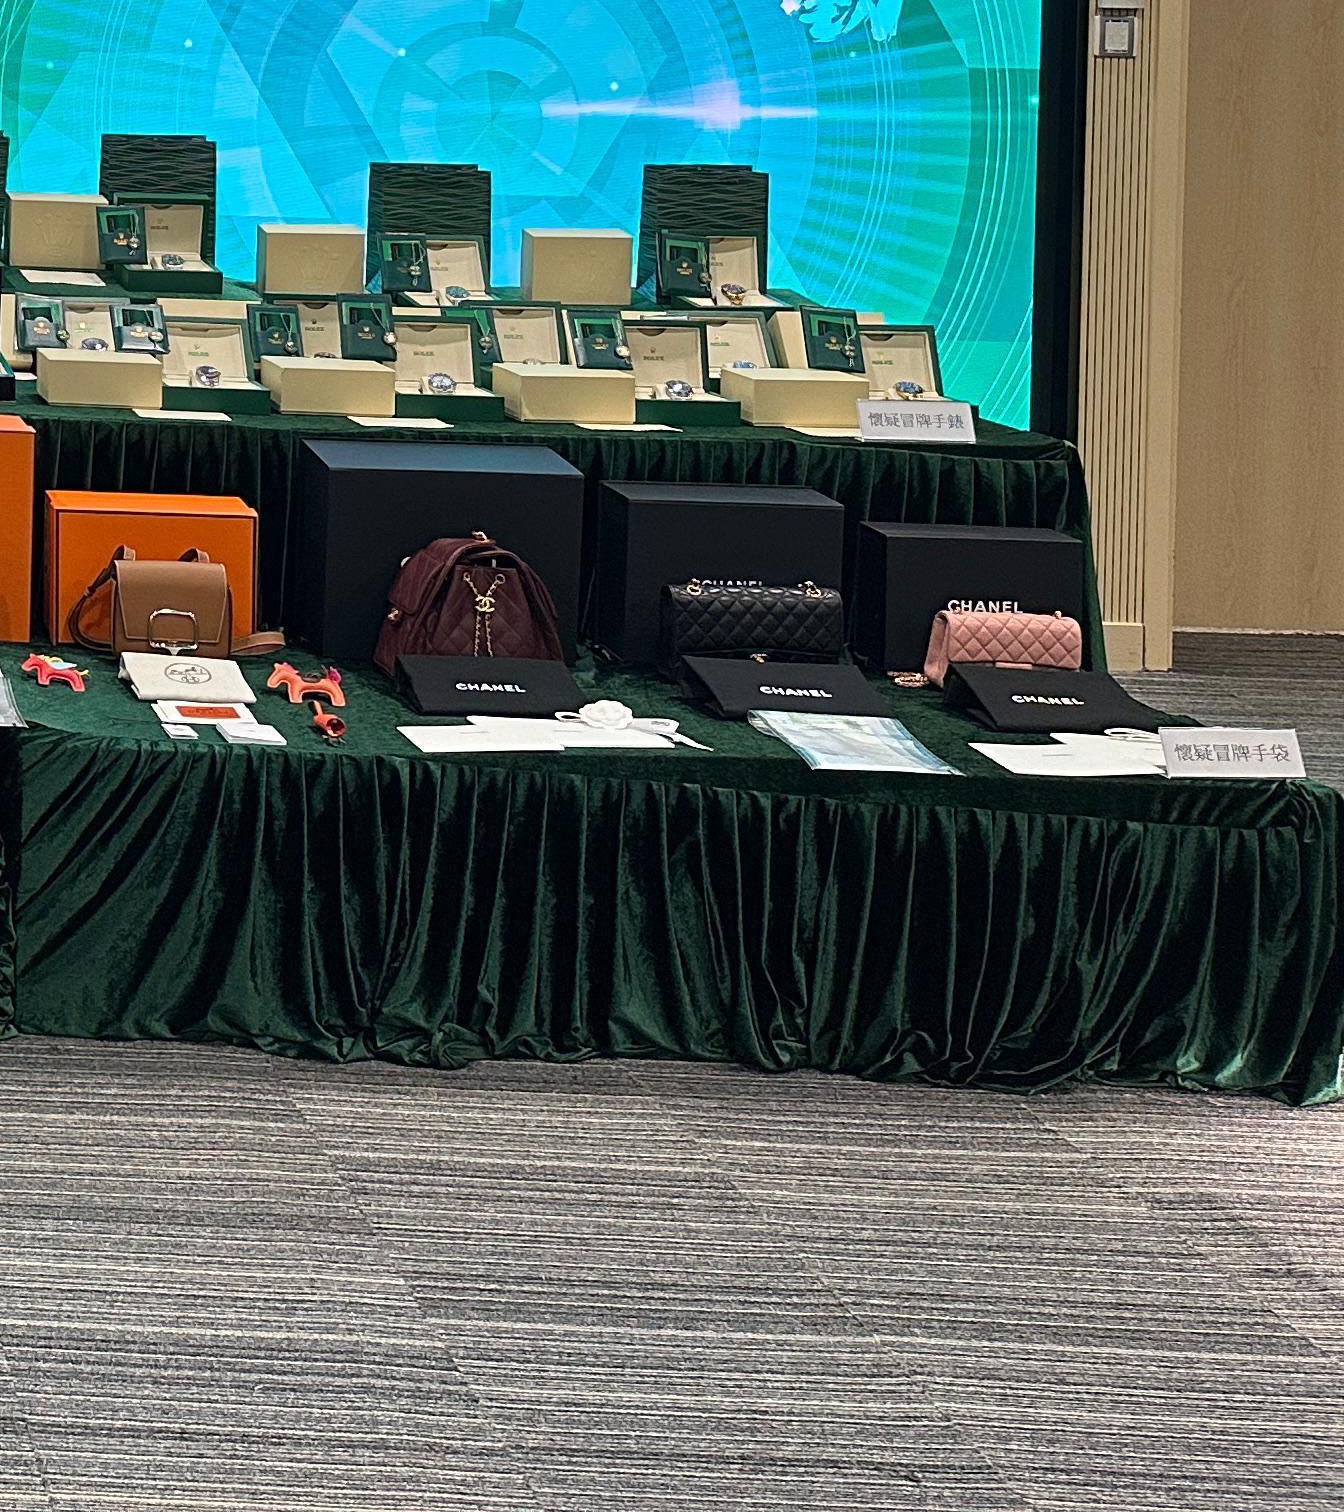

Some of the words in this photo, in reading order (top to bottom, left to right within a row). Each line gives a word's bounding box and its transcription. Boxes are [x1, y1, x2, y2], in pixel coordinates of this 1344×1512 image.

[867, 411, 965, 429] 懷疑冒牌手錶
[947, 599, 1024, 614] CHANEL
[455, 681, 527, 693] CHANEL
[759, 685, 833, 698] CHANEL
[1011, 695, 1085, 706] CHANEL
[1173, 743, 1291, 763] 懷疑冒牌手袋
